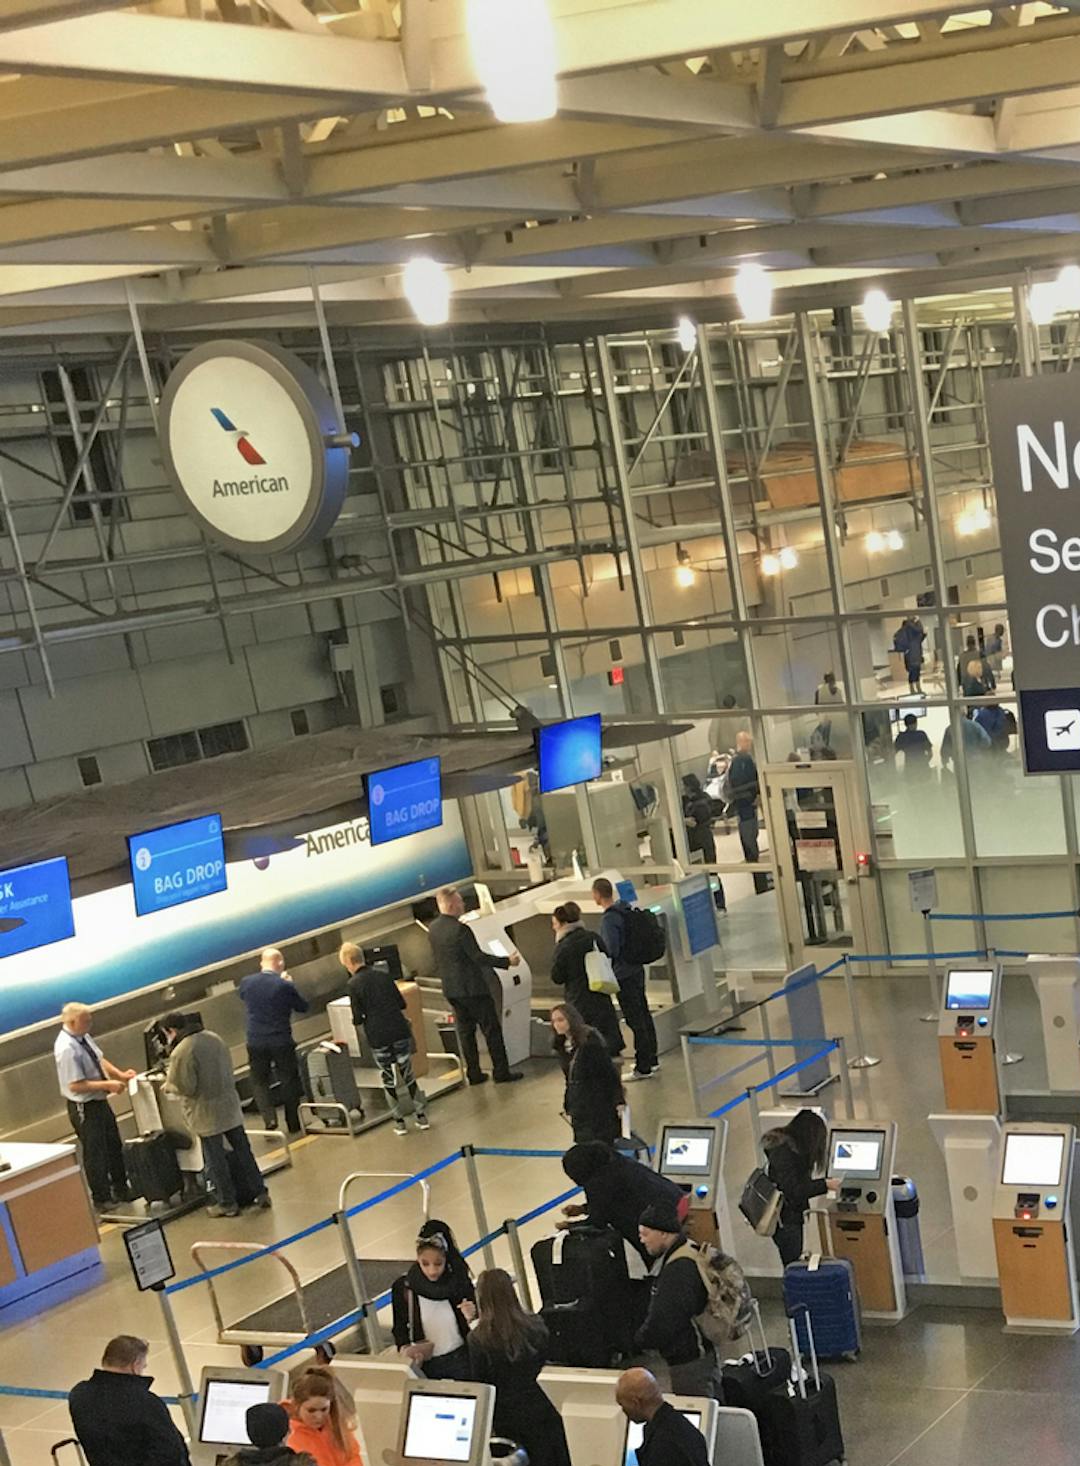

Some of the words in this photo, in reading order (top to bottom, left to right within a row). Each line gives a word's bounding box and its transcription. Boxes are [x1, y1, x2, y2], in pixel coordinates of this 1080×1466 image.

[212, 475, 289, 498] American
[384, 807, 409, 827] BAG
[410, 798, 440, 819] DROP
[154, 871, 183, 894] BAG
[186, 860, 223, 885] DROP
